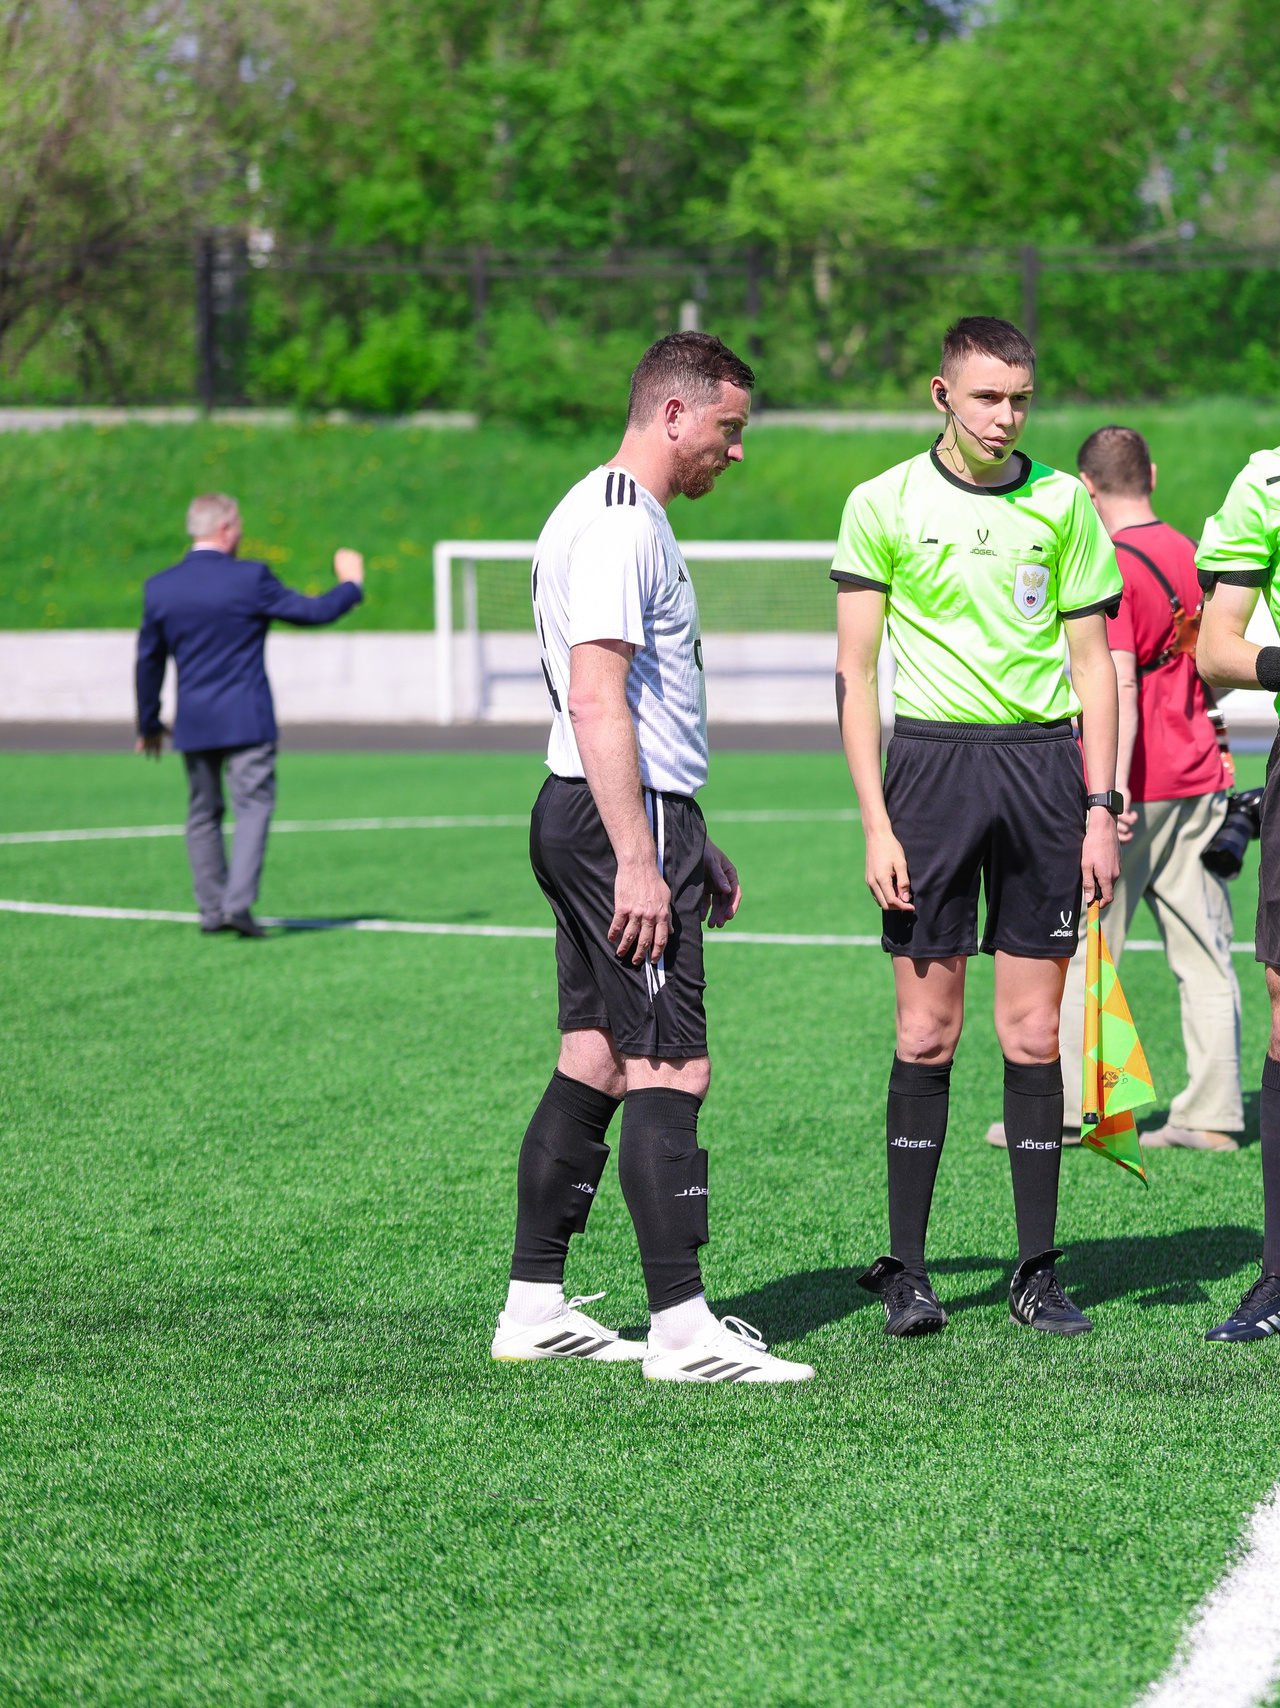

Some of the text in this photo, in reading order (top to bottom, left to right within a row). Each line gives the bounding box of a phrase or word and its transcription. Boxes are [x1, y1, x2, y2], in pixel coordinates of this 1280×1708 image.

[1049, 929, 1074, 937] JÖGE
[890, 1136, 937, 1149] JÖGEL
[1016, 1138, 1060, 1150] JÖGEL
